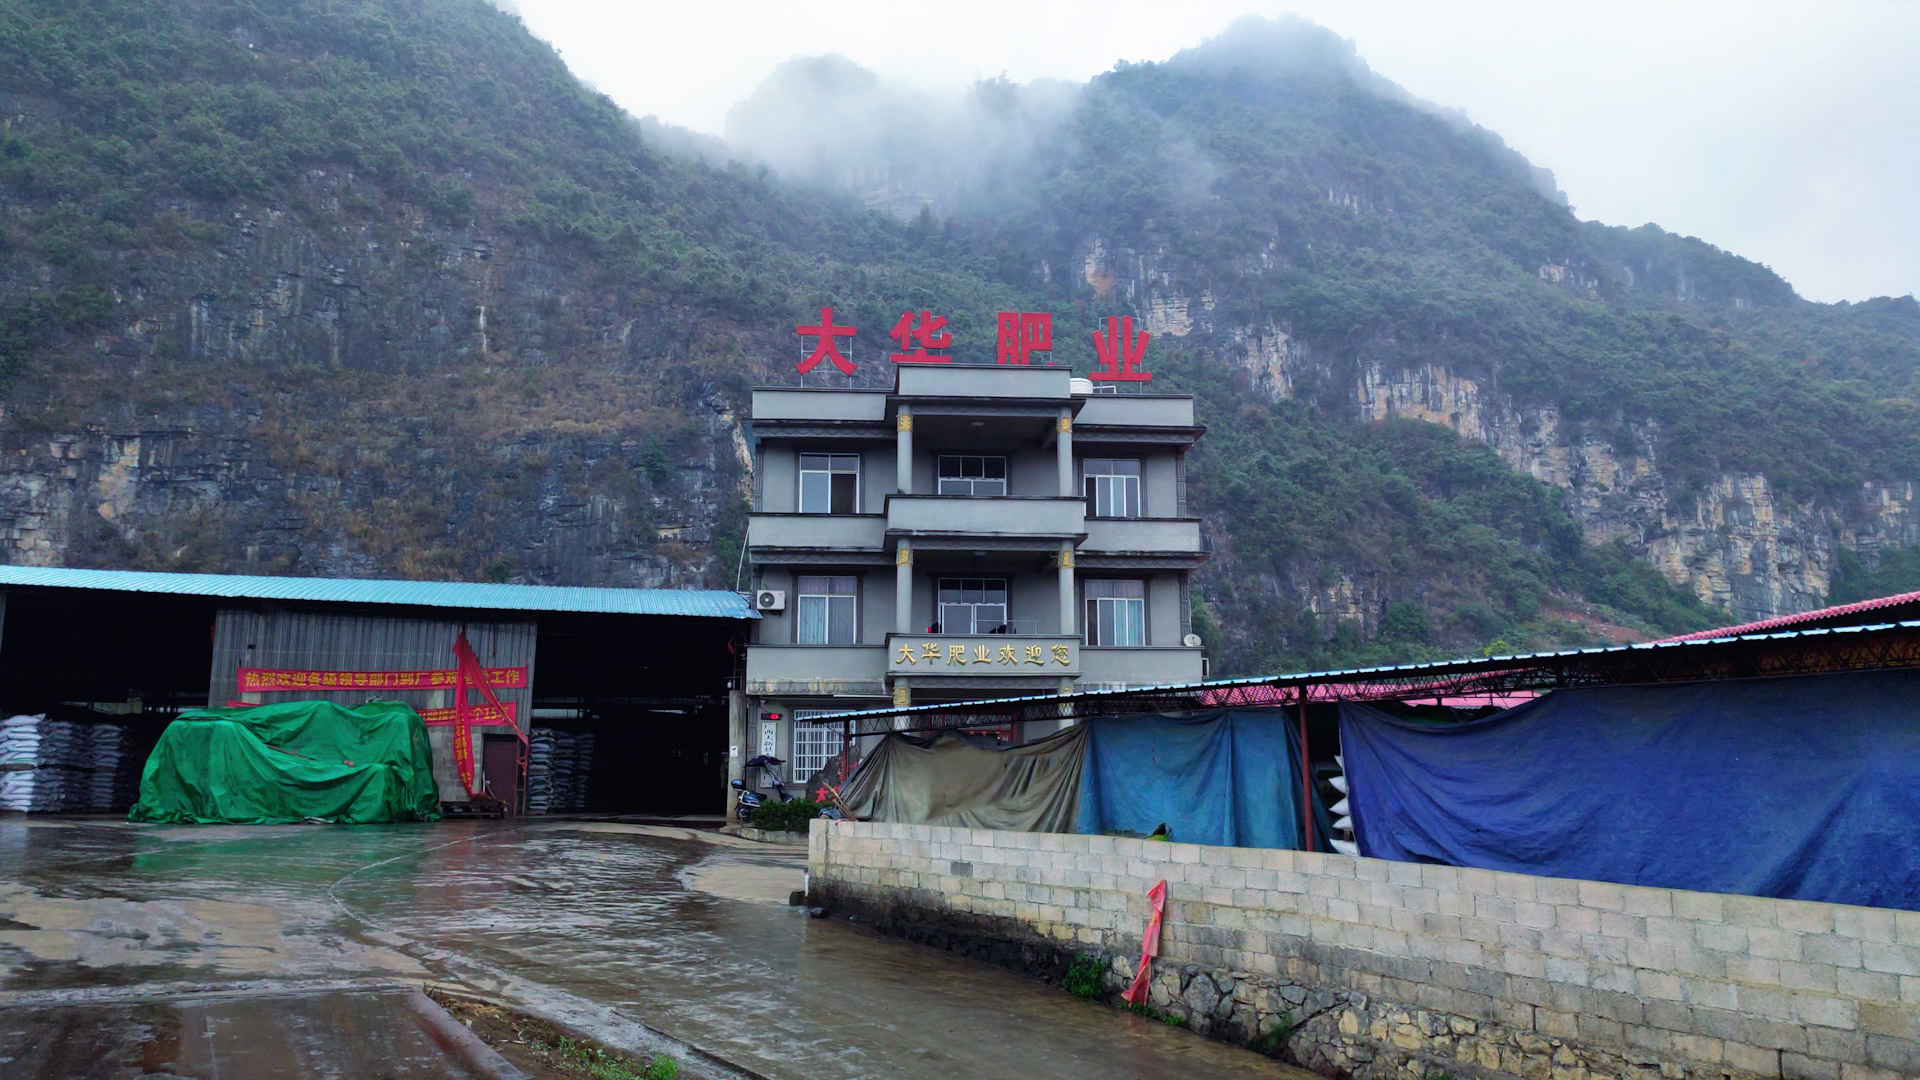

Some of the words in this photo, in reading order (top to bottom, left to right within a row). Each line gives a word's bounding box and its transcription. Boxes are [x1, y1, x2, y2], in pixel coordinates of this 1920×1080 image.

[796, 307, 1152, 381] 大华肥业
[895, 641, 1071, 667] 大华肥业欢迎您
[246, 670, 520, 688] 热烈欢迎各级领导部门到厂参观工作
